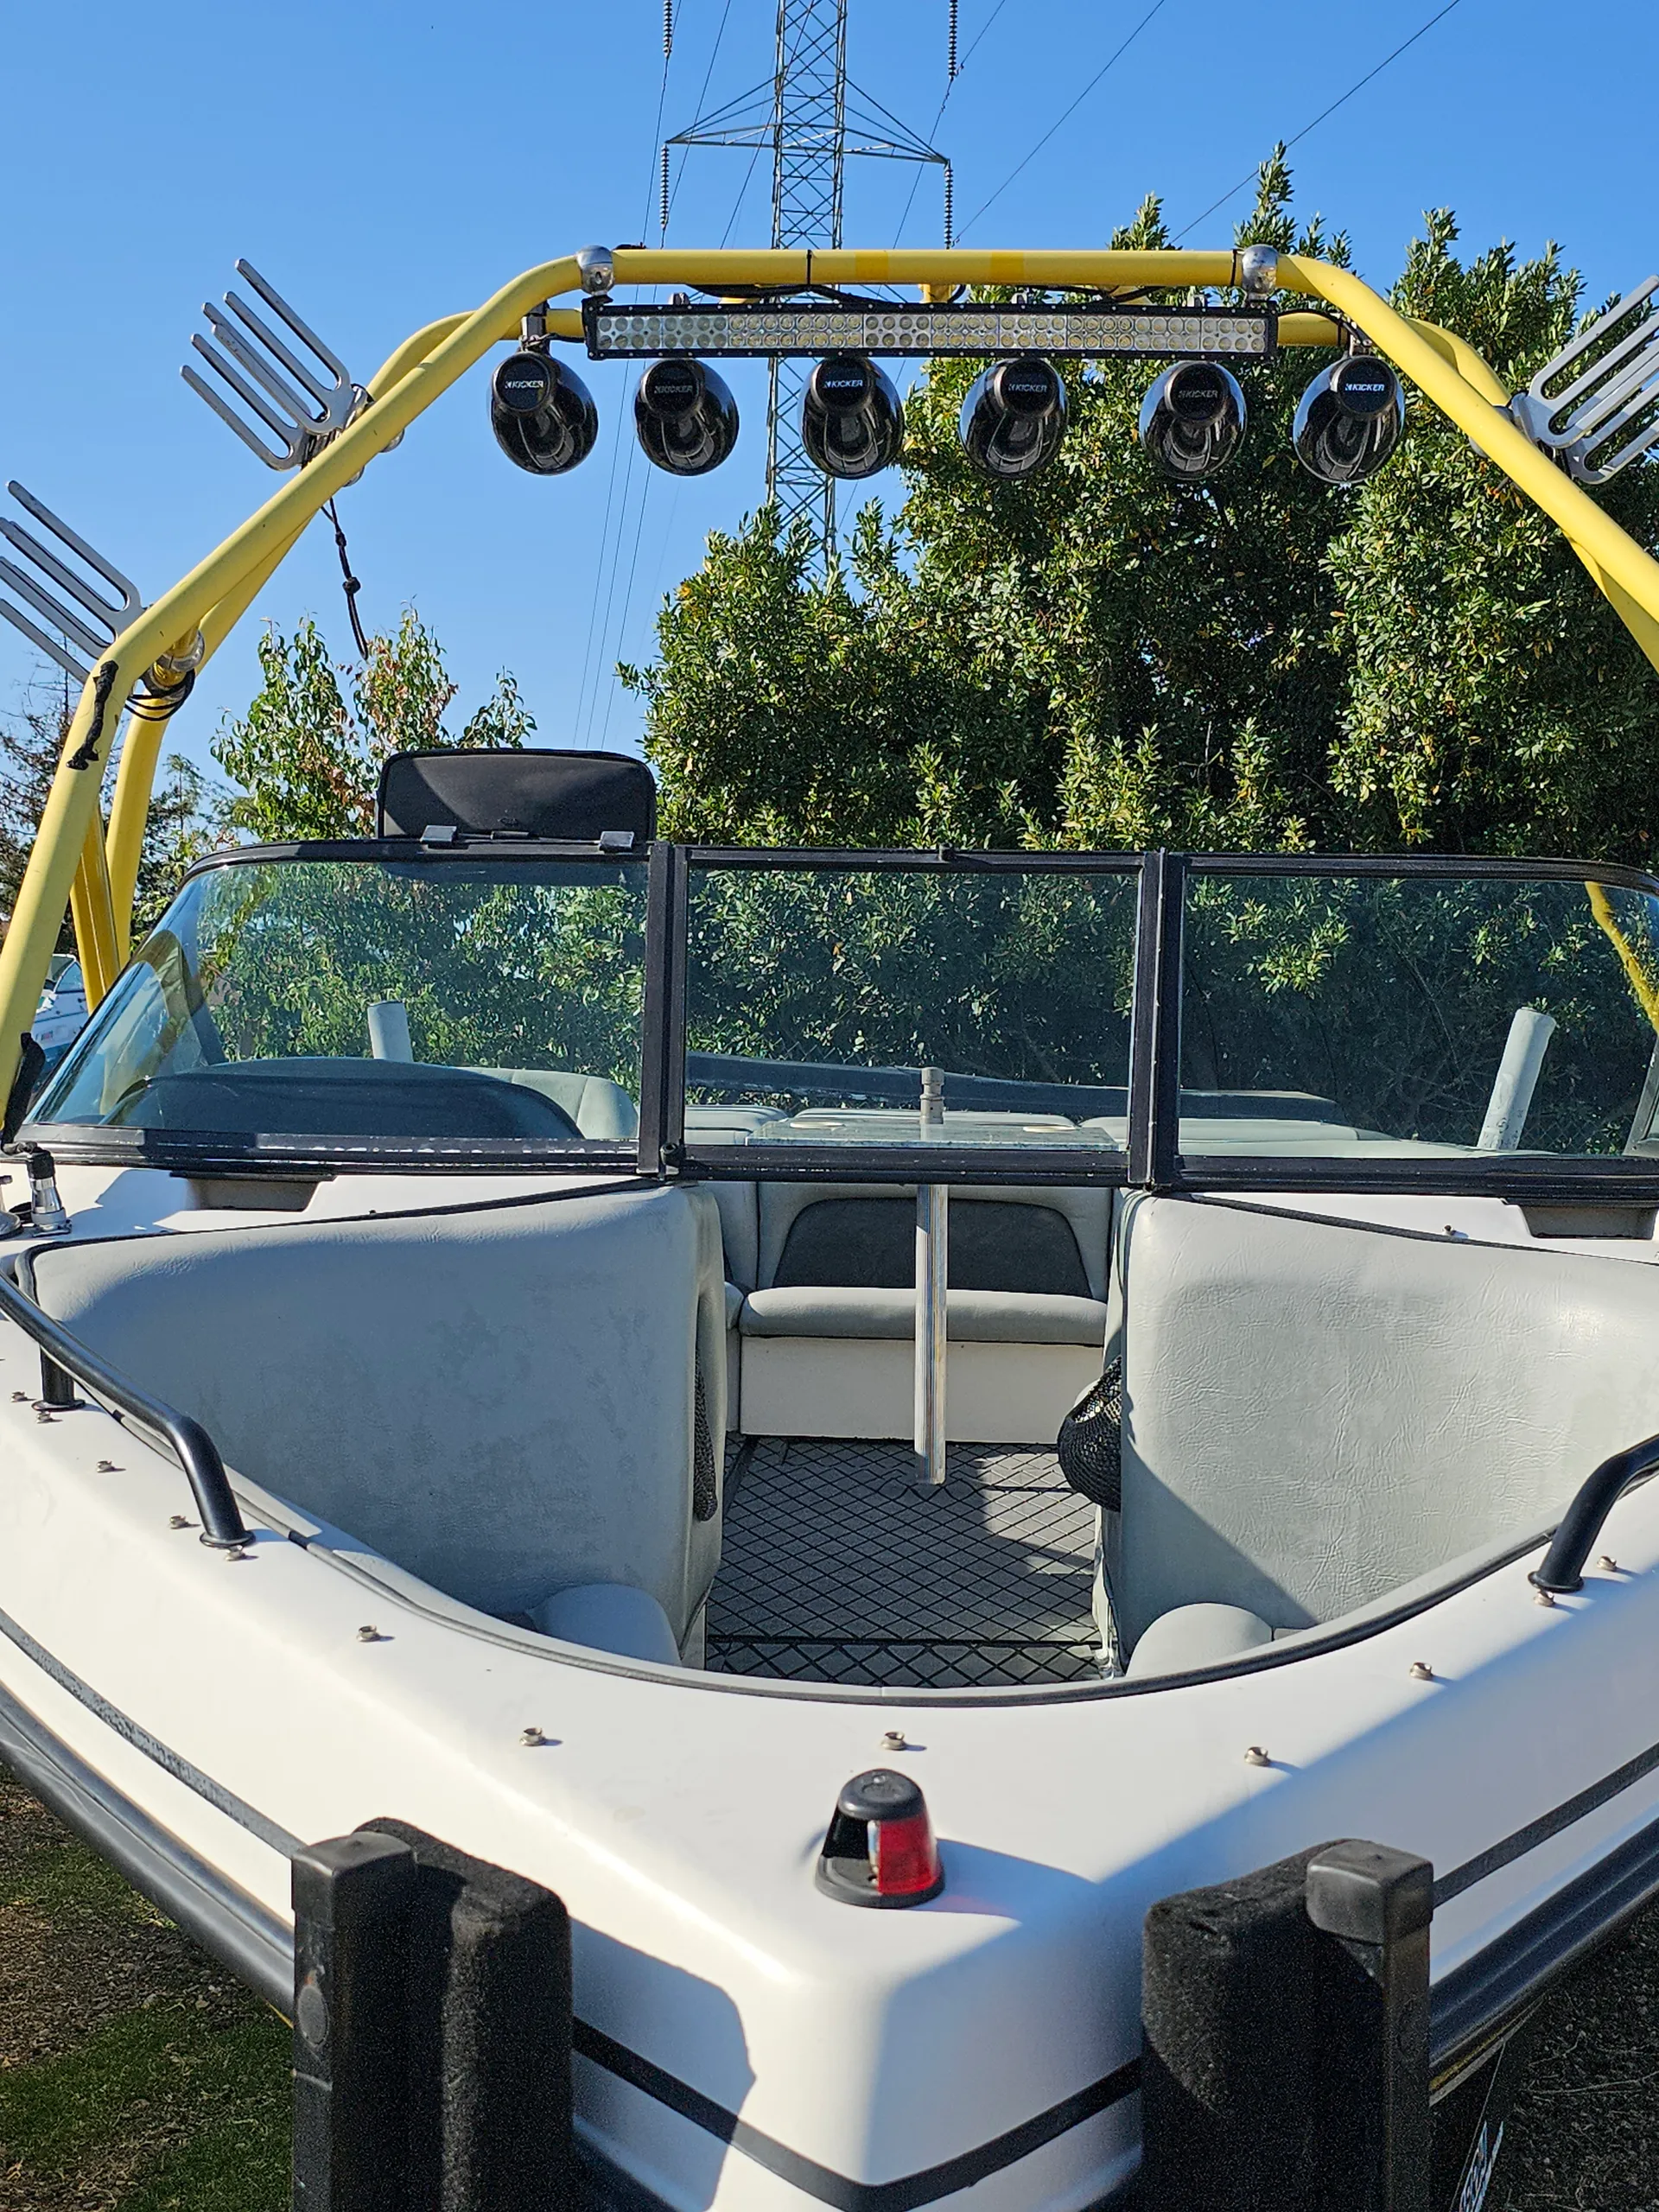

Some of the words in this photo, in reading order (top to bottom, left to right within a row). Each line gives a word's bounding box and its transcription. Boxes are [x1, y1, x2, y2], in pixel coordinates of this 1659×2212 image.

[512, 380, 544, 389] KICKER
[831, 379, 863, 388] KICKER
[1351, 383, 1385, 391] KICKER
[1015, 384, 1048, 392] KICKER
[1185, 390, 1218, 398] KICKER
